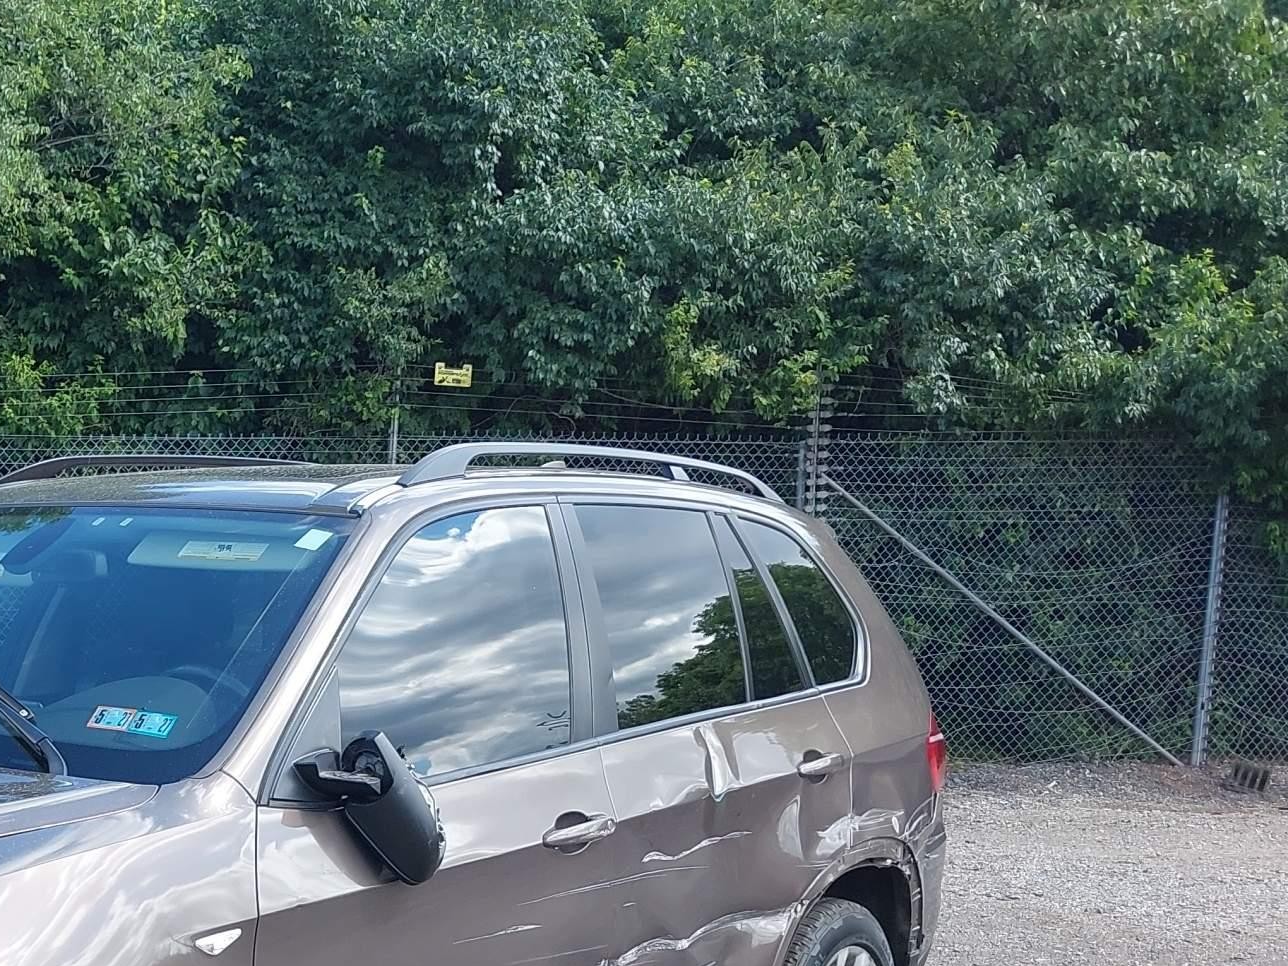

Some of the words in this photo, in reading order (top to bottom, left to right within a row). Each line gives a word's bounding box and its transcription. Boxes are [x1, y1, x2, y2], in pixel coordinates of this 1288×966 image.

[94, 709, 107, 724] 5
[117, 711, 132, 728] 27
[134, 713, 147, 729] 5
[157, 717, 173, 733] 27
